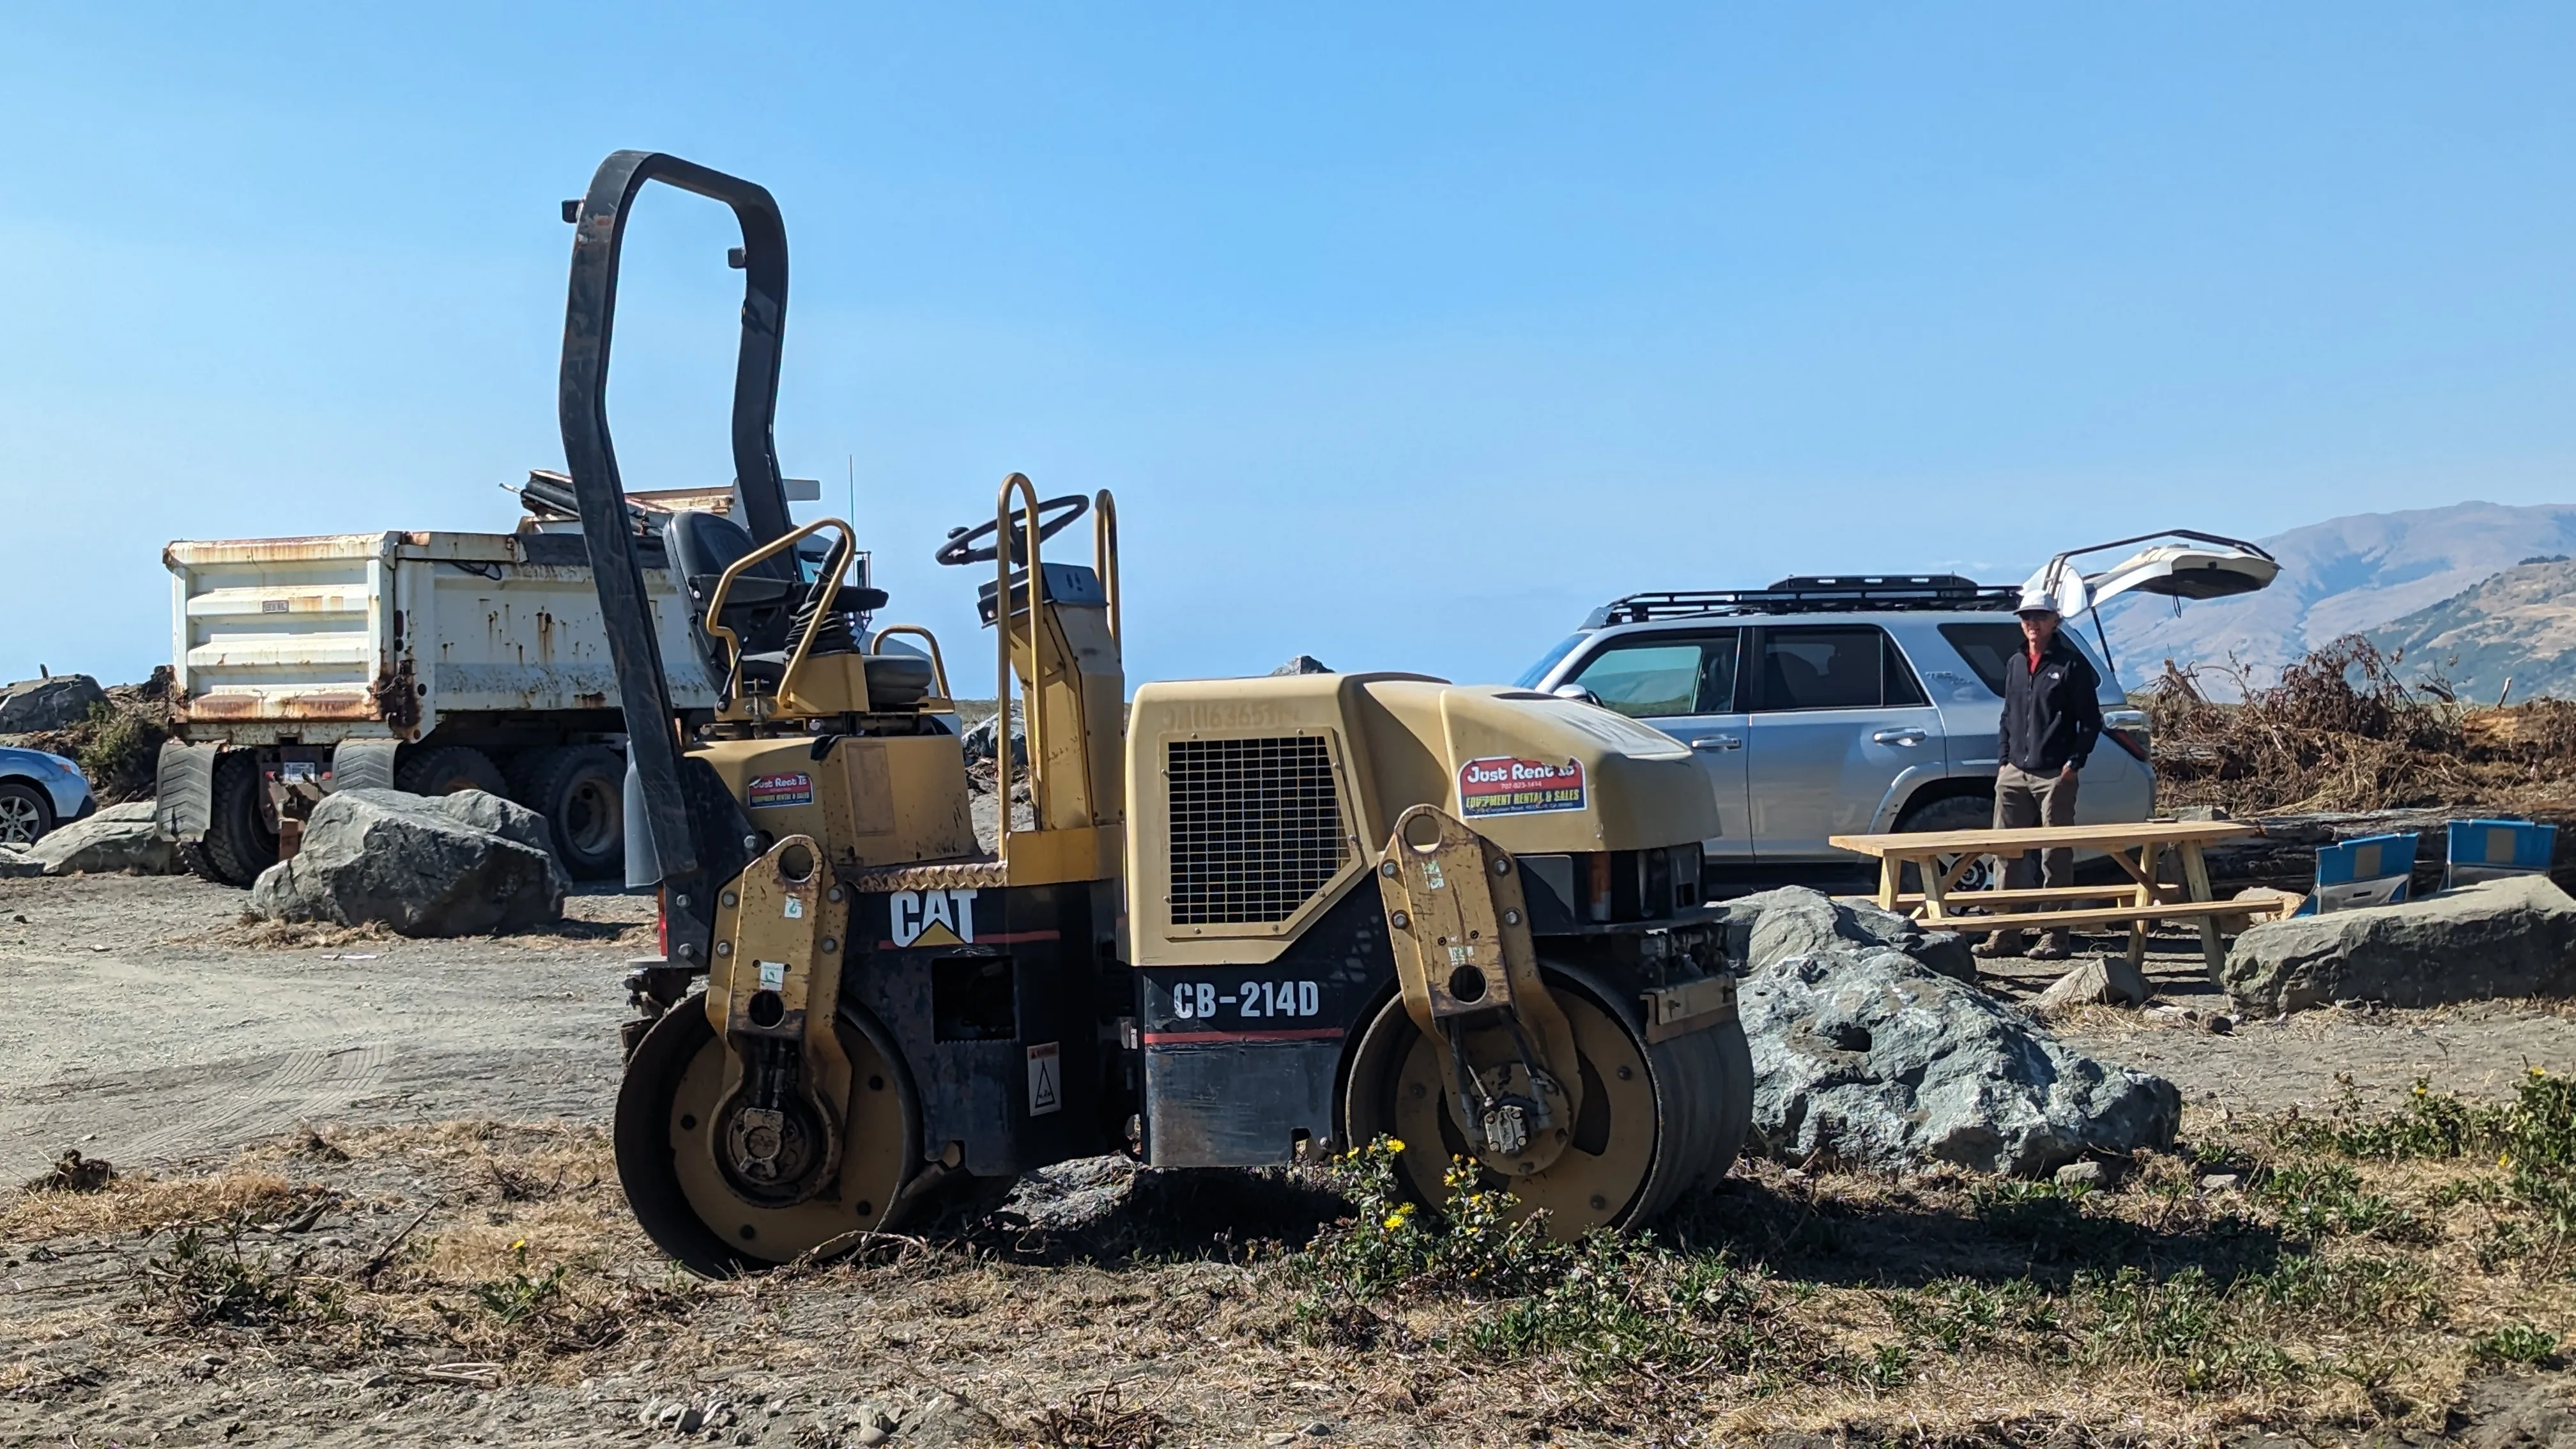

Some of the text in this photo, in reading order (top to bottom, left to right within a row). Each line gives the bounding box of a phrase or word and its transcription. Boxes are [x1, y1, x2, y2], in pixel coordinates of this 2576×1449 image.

[1467, 766, 1508, 783] Just
[1512, 763, 1554, 780] Rent
[1513, 791, 1543, 805] RENTAL
[1554, 788, 1579, 802] SALES
[891, 889, 978, 947] CAT
[1174, 981, 1319, 1019] CB-214D
